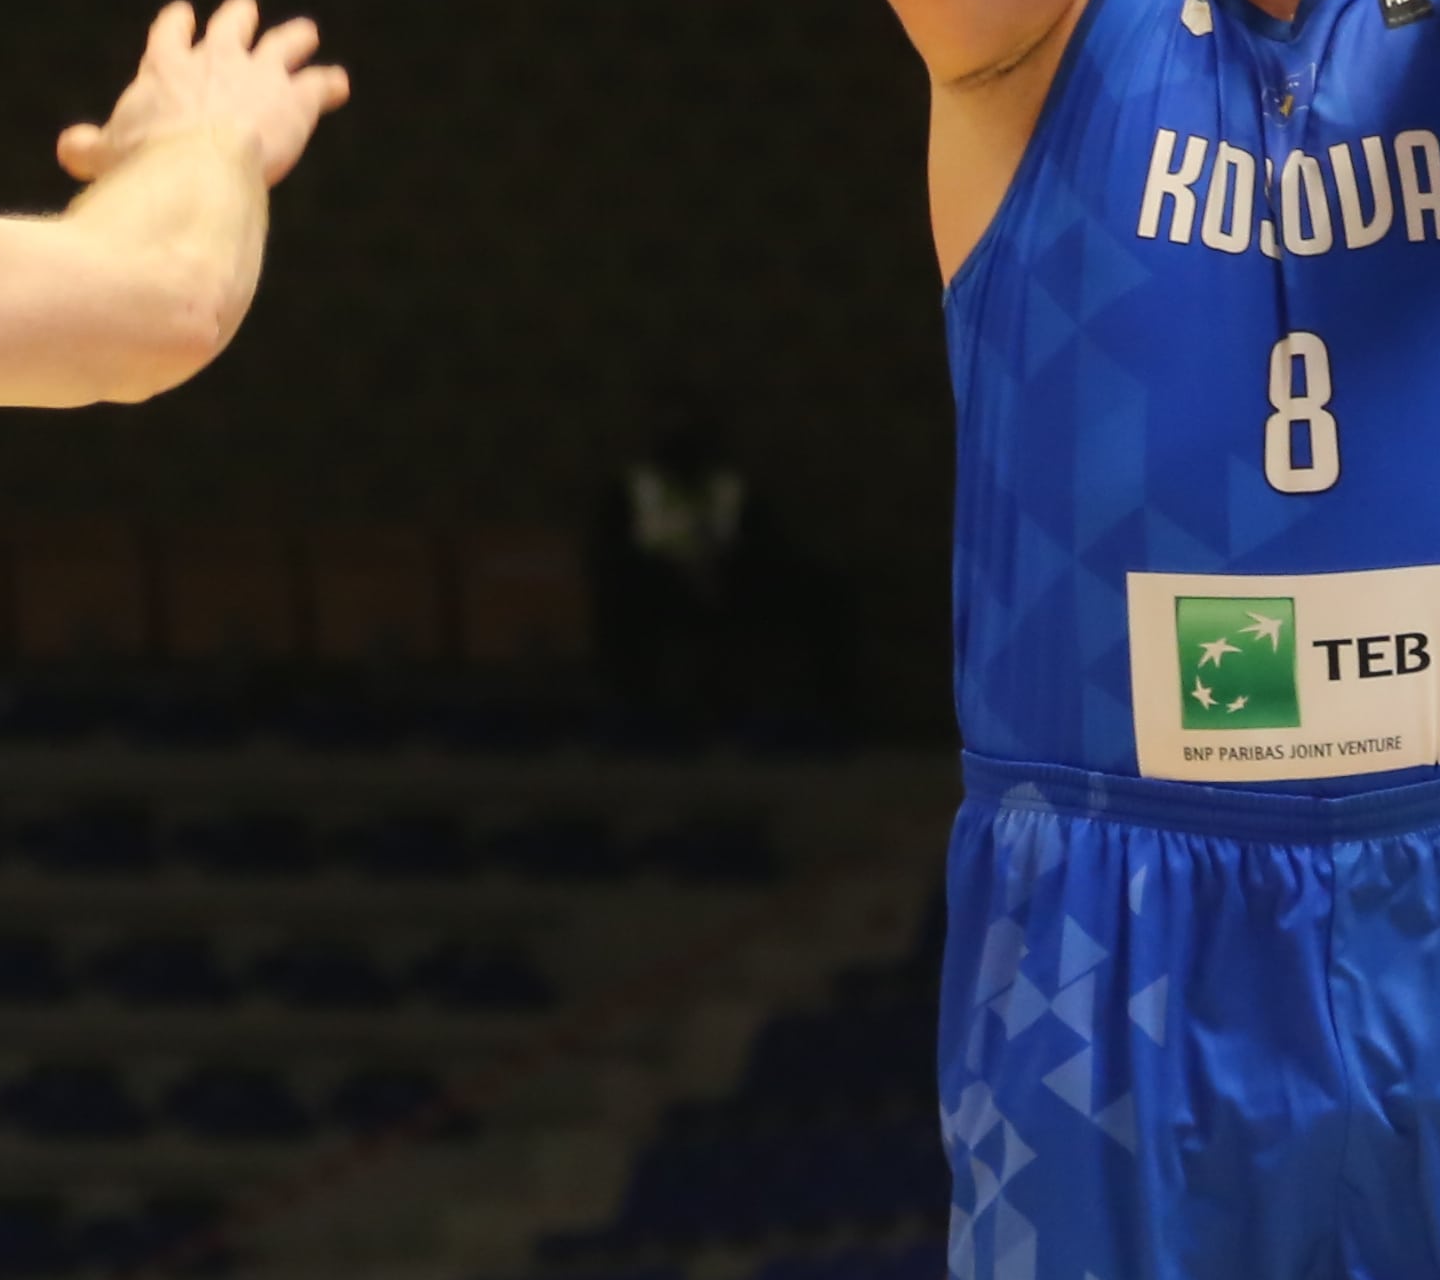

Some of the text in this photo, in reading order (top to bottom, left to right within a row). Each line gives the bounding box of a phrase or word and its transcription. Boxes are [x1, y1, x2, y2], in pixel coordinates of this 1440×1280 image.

[1263, 331, 1341, 494] 8
[1312, 632, 1431, 681] TEB
[1183, 736, 1402, 761] BNP PARIBAS JOINT VENTURE
